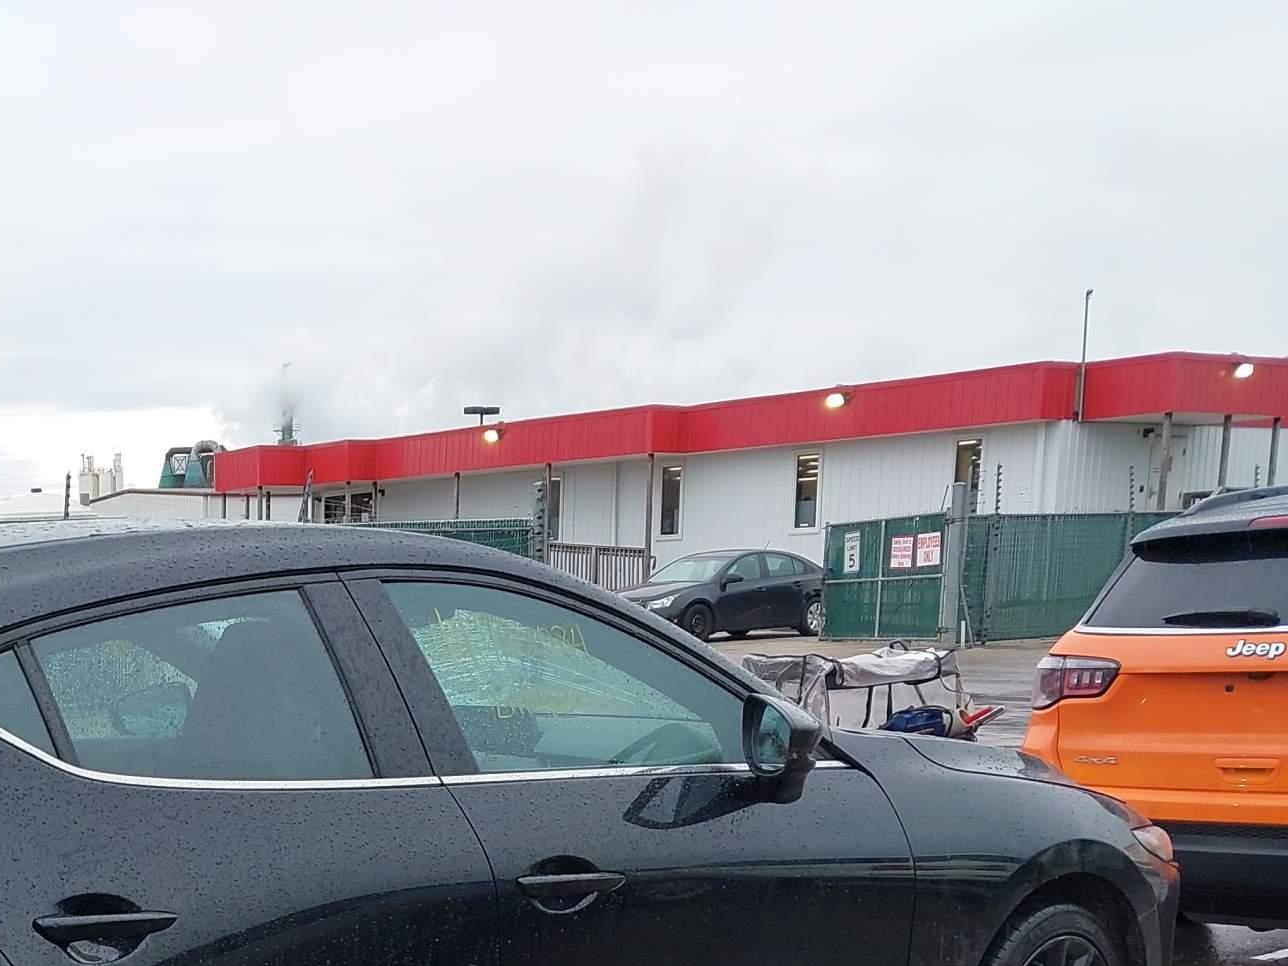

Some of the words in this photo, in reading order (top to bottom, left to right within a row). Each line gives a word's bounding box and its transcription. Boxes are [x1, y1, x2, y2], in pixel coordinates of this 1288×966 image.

[918, 535, 940, 549] EMPLOYEES
[848, 553, 855, 568] 5
[923, 550, 934, 563] ONLY
[1226, 639, 1286, 660] Jeep
